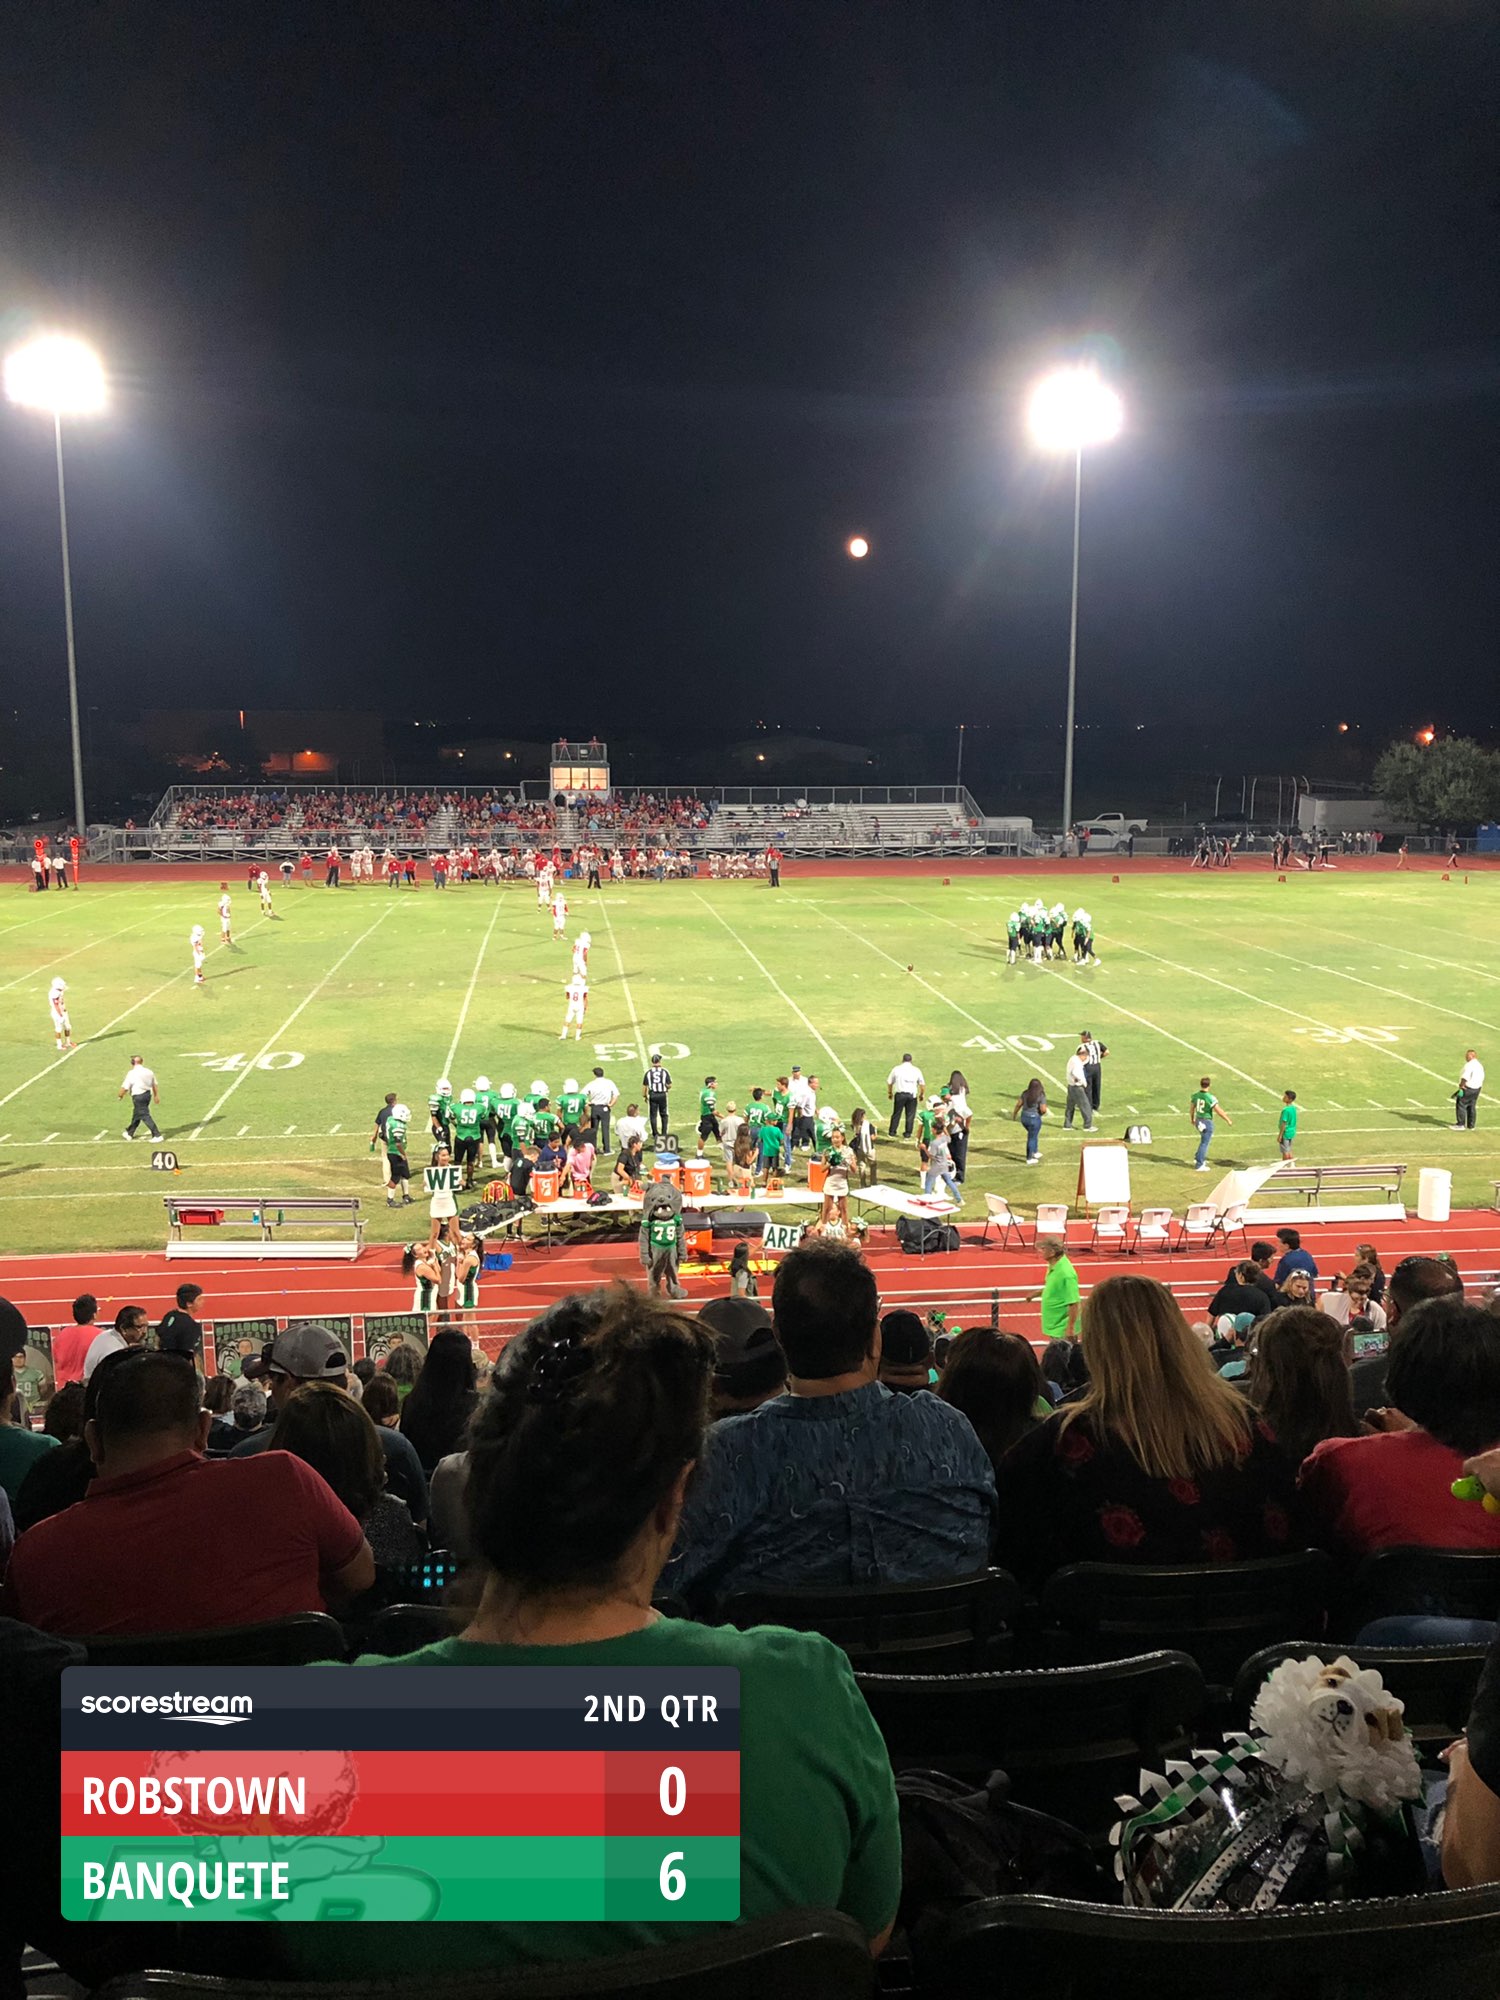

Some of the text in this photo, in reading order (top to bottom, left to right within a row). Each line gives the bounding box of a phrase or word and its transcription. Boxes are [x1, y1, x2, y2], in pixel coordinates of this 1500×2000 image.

[961, 1034, 1055, 1052] 40
[593, 1042, 691, 1062] 50
[200, 1051, 305, 1072] 40
[653, 1071, 661, 1084] S
[497, 1103, 513, 1120] 64
[567, 1100, 580, 1114] 21
[1196, 1098, 1206, 1114] 12
[460, 1108, 478, 1124] 59
[1128, 1125, 1153, 1144] 40
[655, 1135, 677, 1152] 50
[152, 1152, 176, 1170] 40
[426, 1168, 461, 1190] WE
